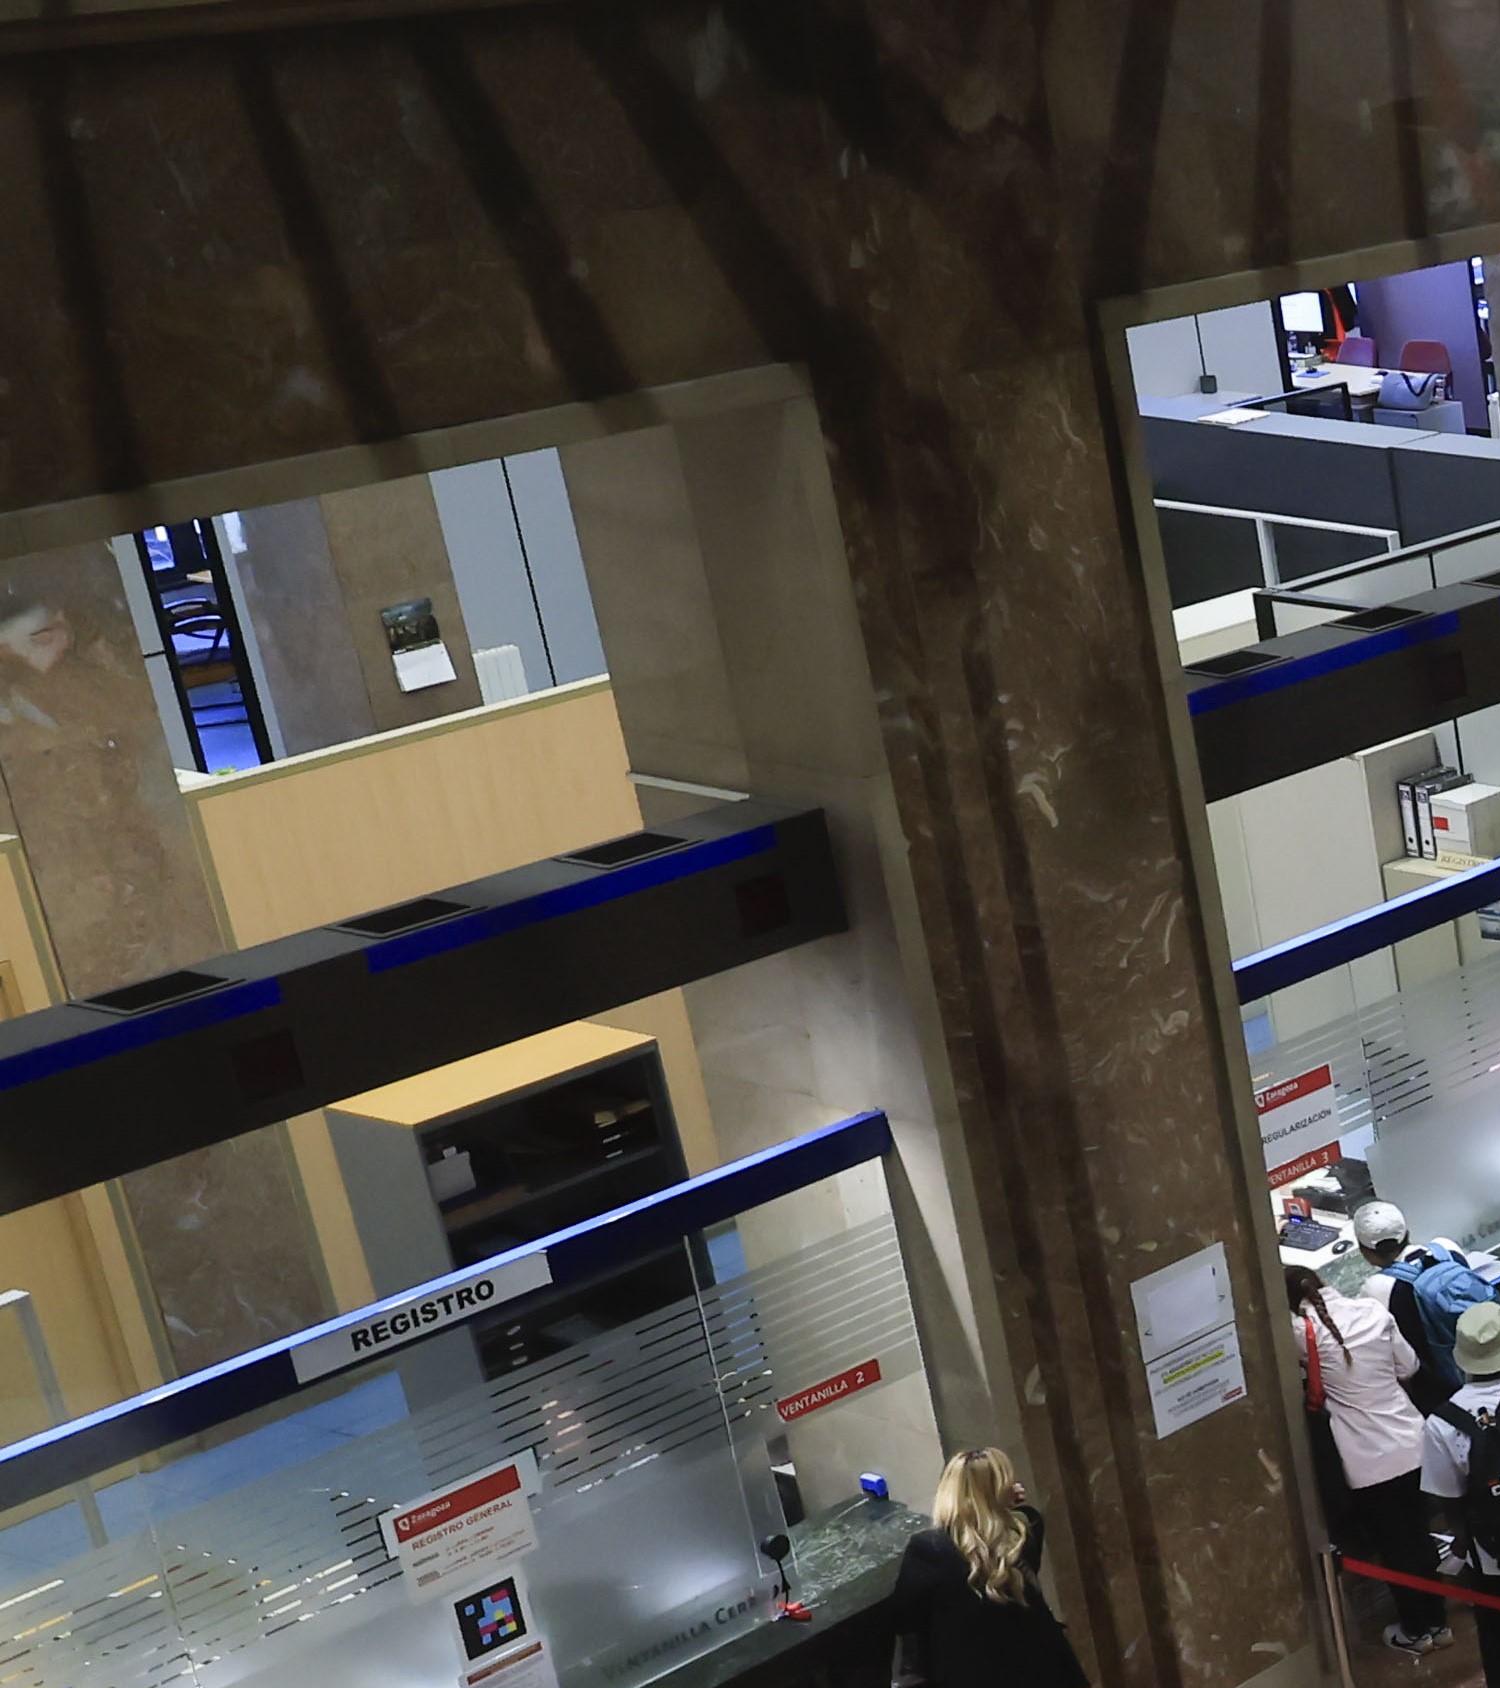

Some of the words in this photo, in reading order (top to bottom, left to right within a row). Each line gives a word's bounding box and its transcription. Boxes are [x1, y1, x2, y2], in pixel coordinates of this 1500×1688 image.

[1262, 1107, 1332, 1145] REGULARIZACIÓN
[1267, 1156, 1318, 1186] ENTANILLA
[1320, 1151, 1330, 1166] 3
[350, 1279, 495, 1352] REGISTRO
[779, 1379, 849, 1418] VENTANILLA
[855, 1370, 865, 1386] 2
[411, 1519, 465, 1551] REGISTRO
[465, 1499, 513, 1527] GENERAL
